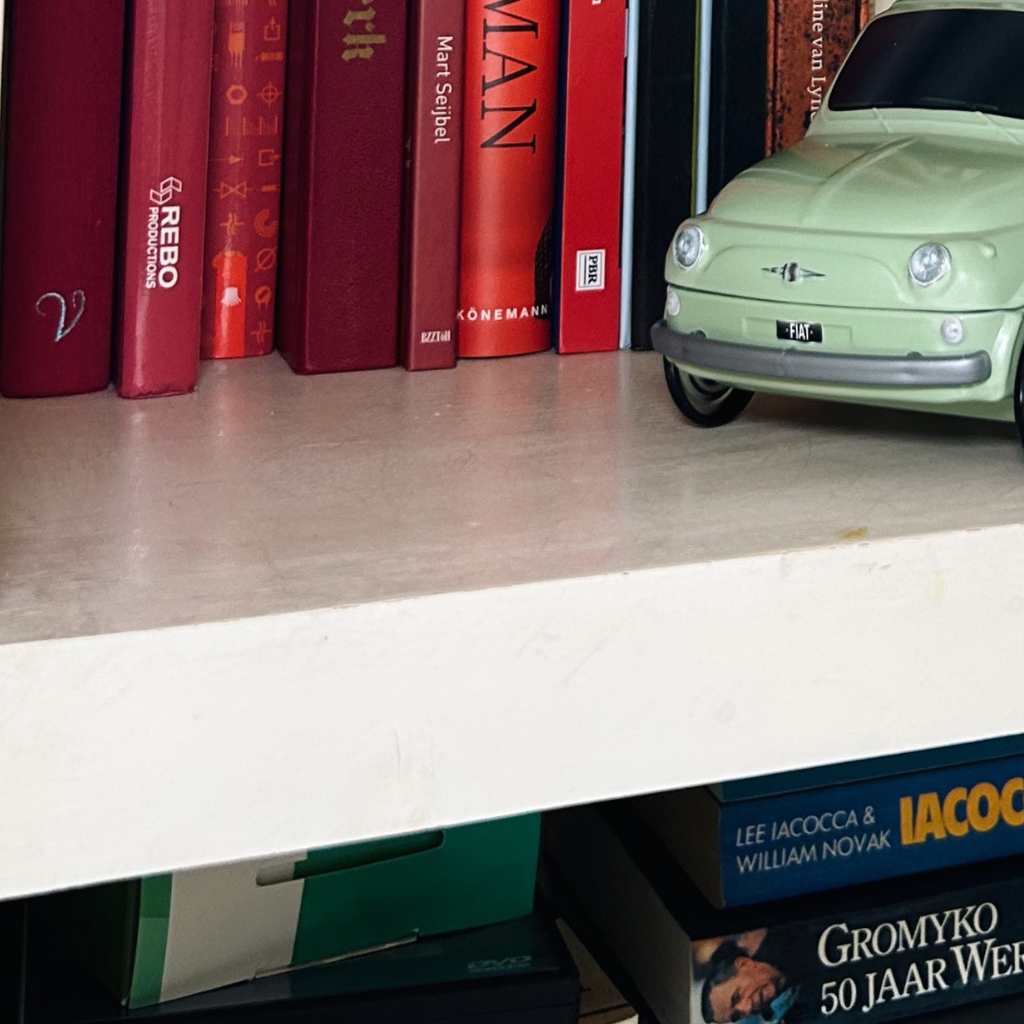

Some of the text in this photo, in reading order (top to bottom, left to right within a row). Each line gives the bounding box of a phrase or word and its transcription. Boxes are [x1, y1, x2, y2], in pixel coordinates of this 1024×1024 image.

[811, 38, 824, 71] van
[431, 35, 453, 144] Mart Seijbel
[145, 207, 159, 289] PRODUCTIONS
[159, 206, 181, 289] REBO
[586, 253, 599, 285] PBR
[457, 304, 548, 321] KÖNEMANN
[788, 323, 811, 340] FIAT
[735, 806, 876, 848] LEE IACOCCA &
[736, 830, 892, 873] WILLIAM NOVAK
[817, 901, 999, 969] GROMYKO
[819, 977, 858, 1015] 50
[860, 958, 950, 1015] JAAR
